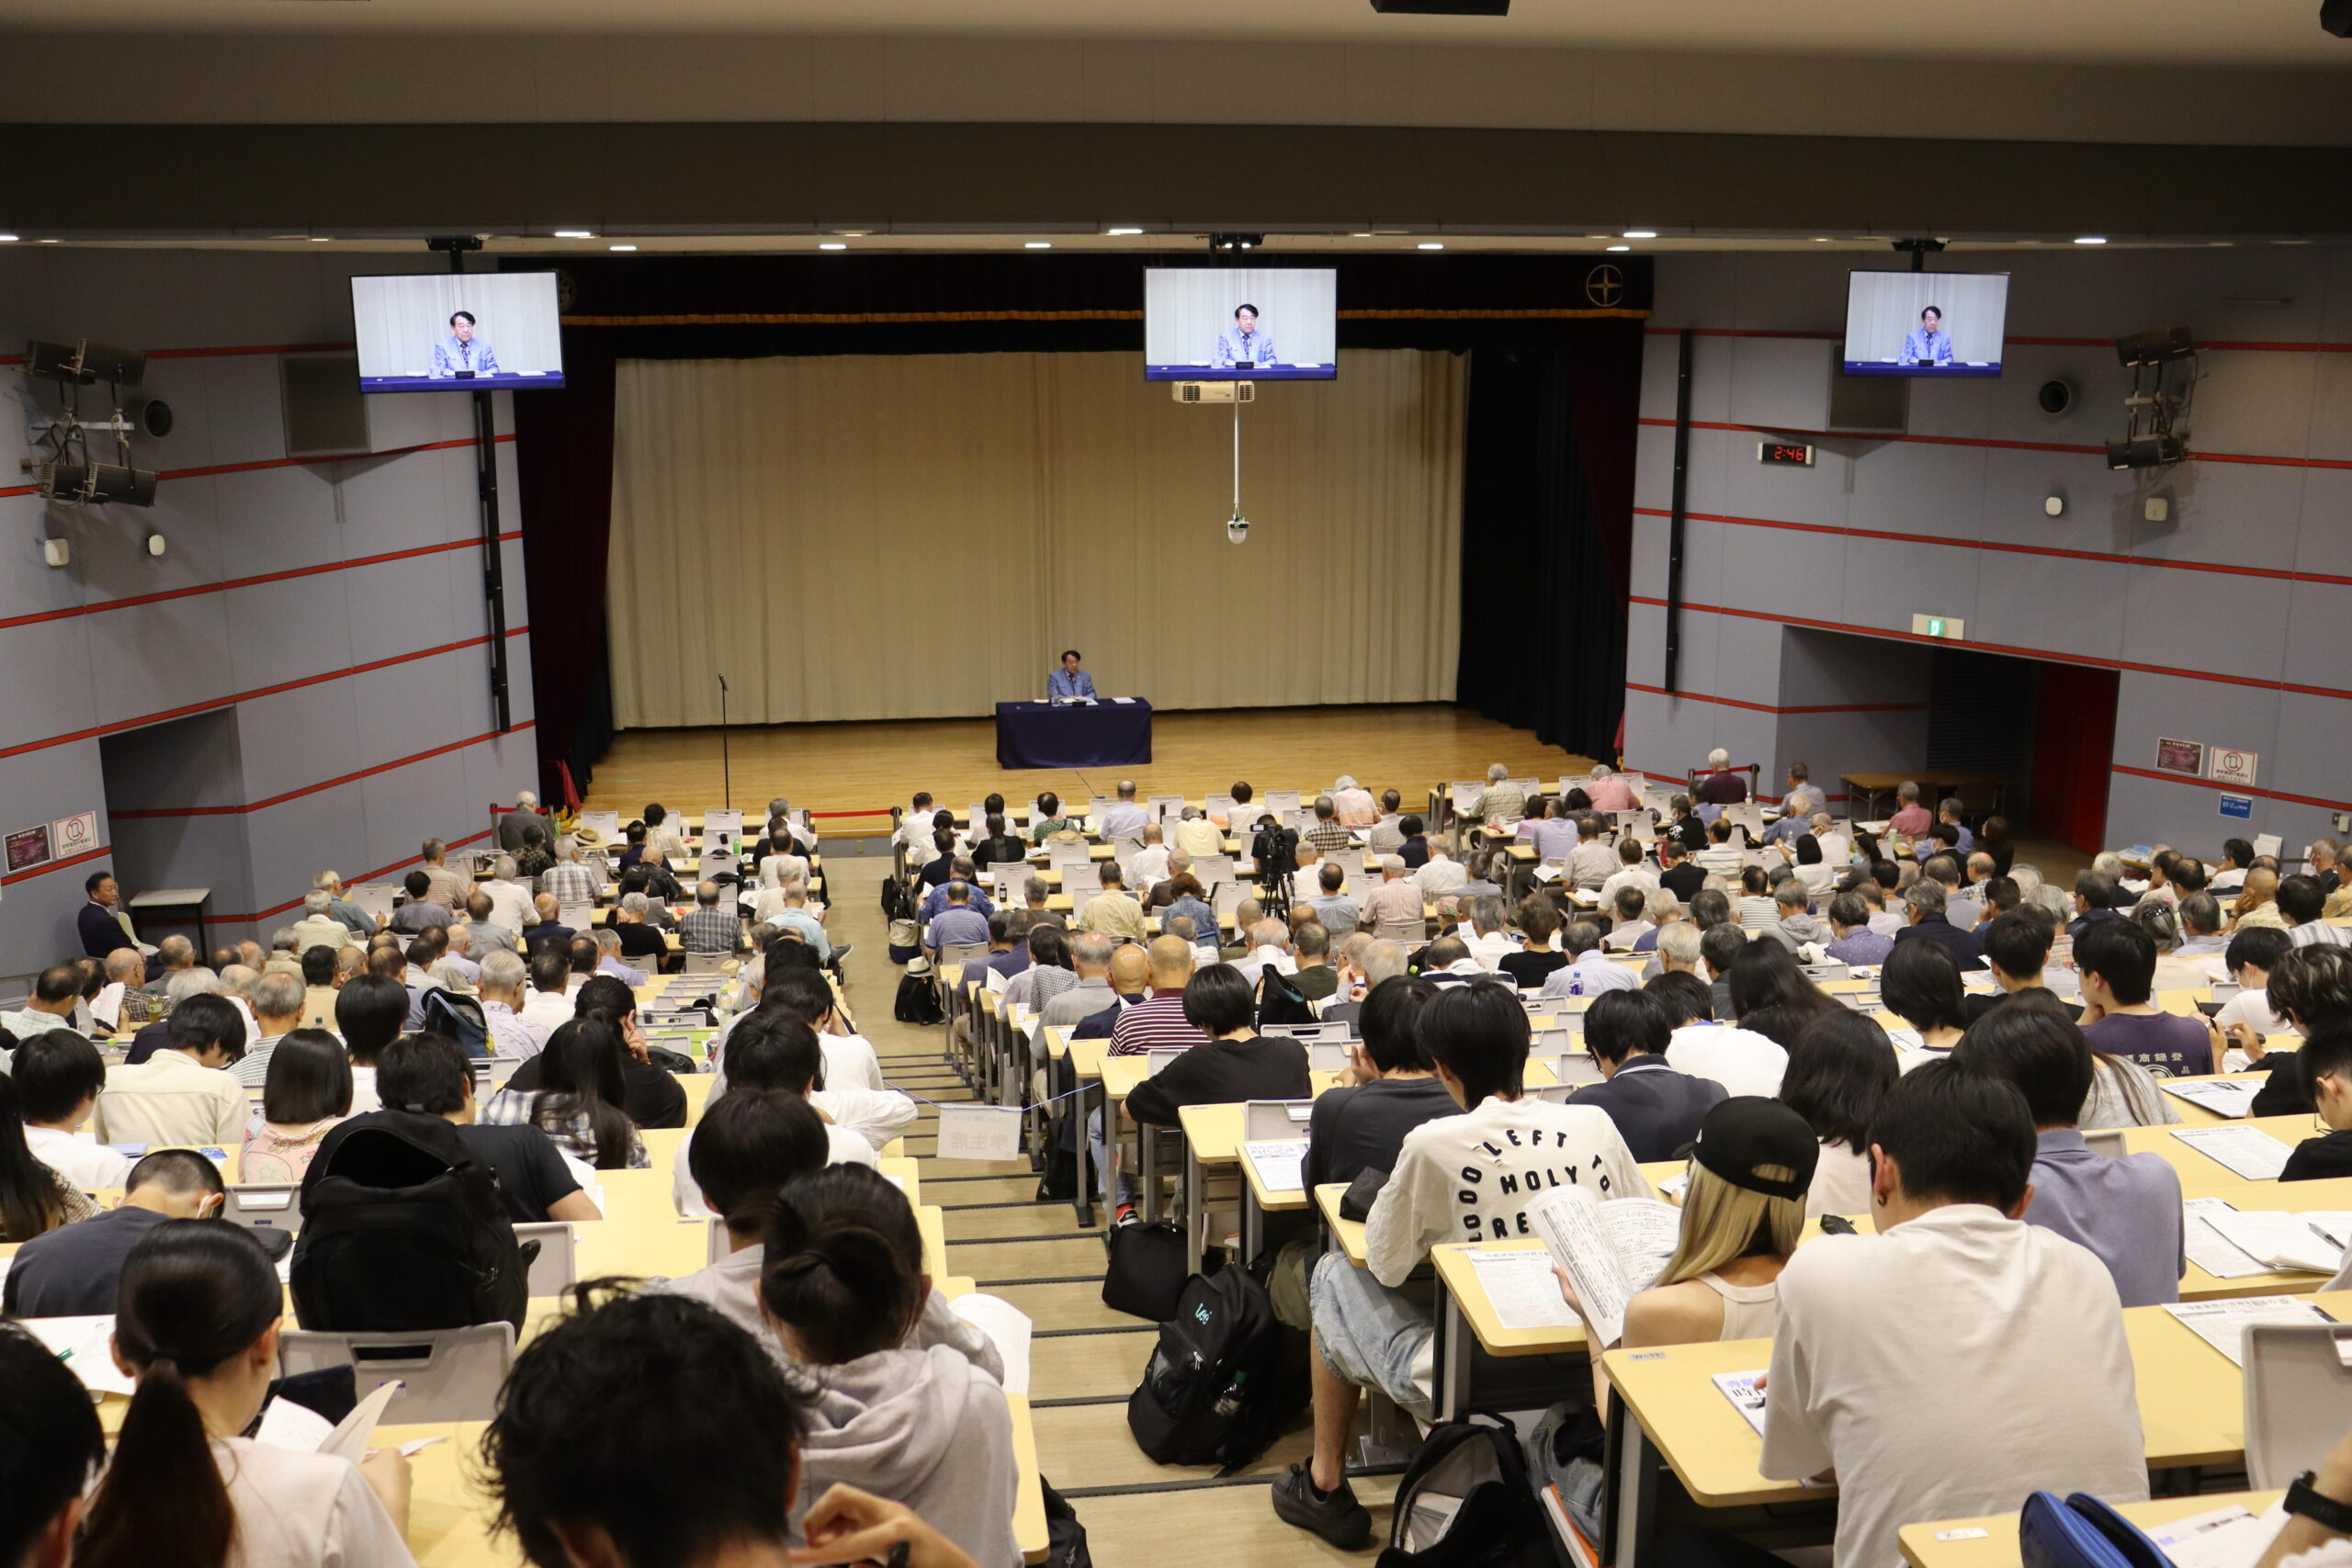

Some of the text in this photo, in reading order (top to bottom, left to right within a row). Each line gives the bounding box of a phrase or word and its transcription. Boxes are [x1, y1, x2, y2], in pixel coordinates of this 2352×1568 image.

[1774, 446, 1804, 461] 2:46
[1482, 1129, 1567, 1156] LEFT
[1499, 1165, 1577, 1195] HOLY
[1194, 1302, 1210, 1325] Lee
